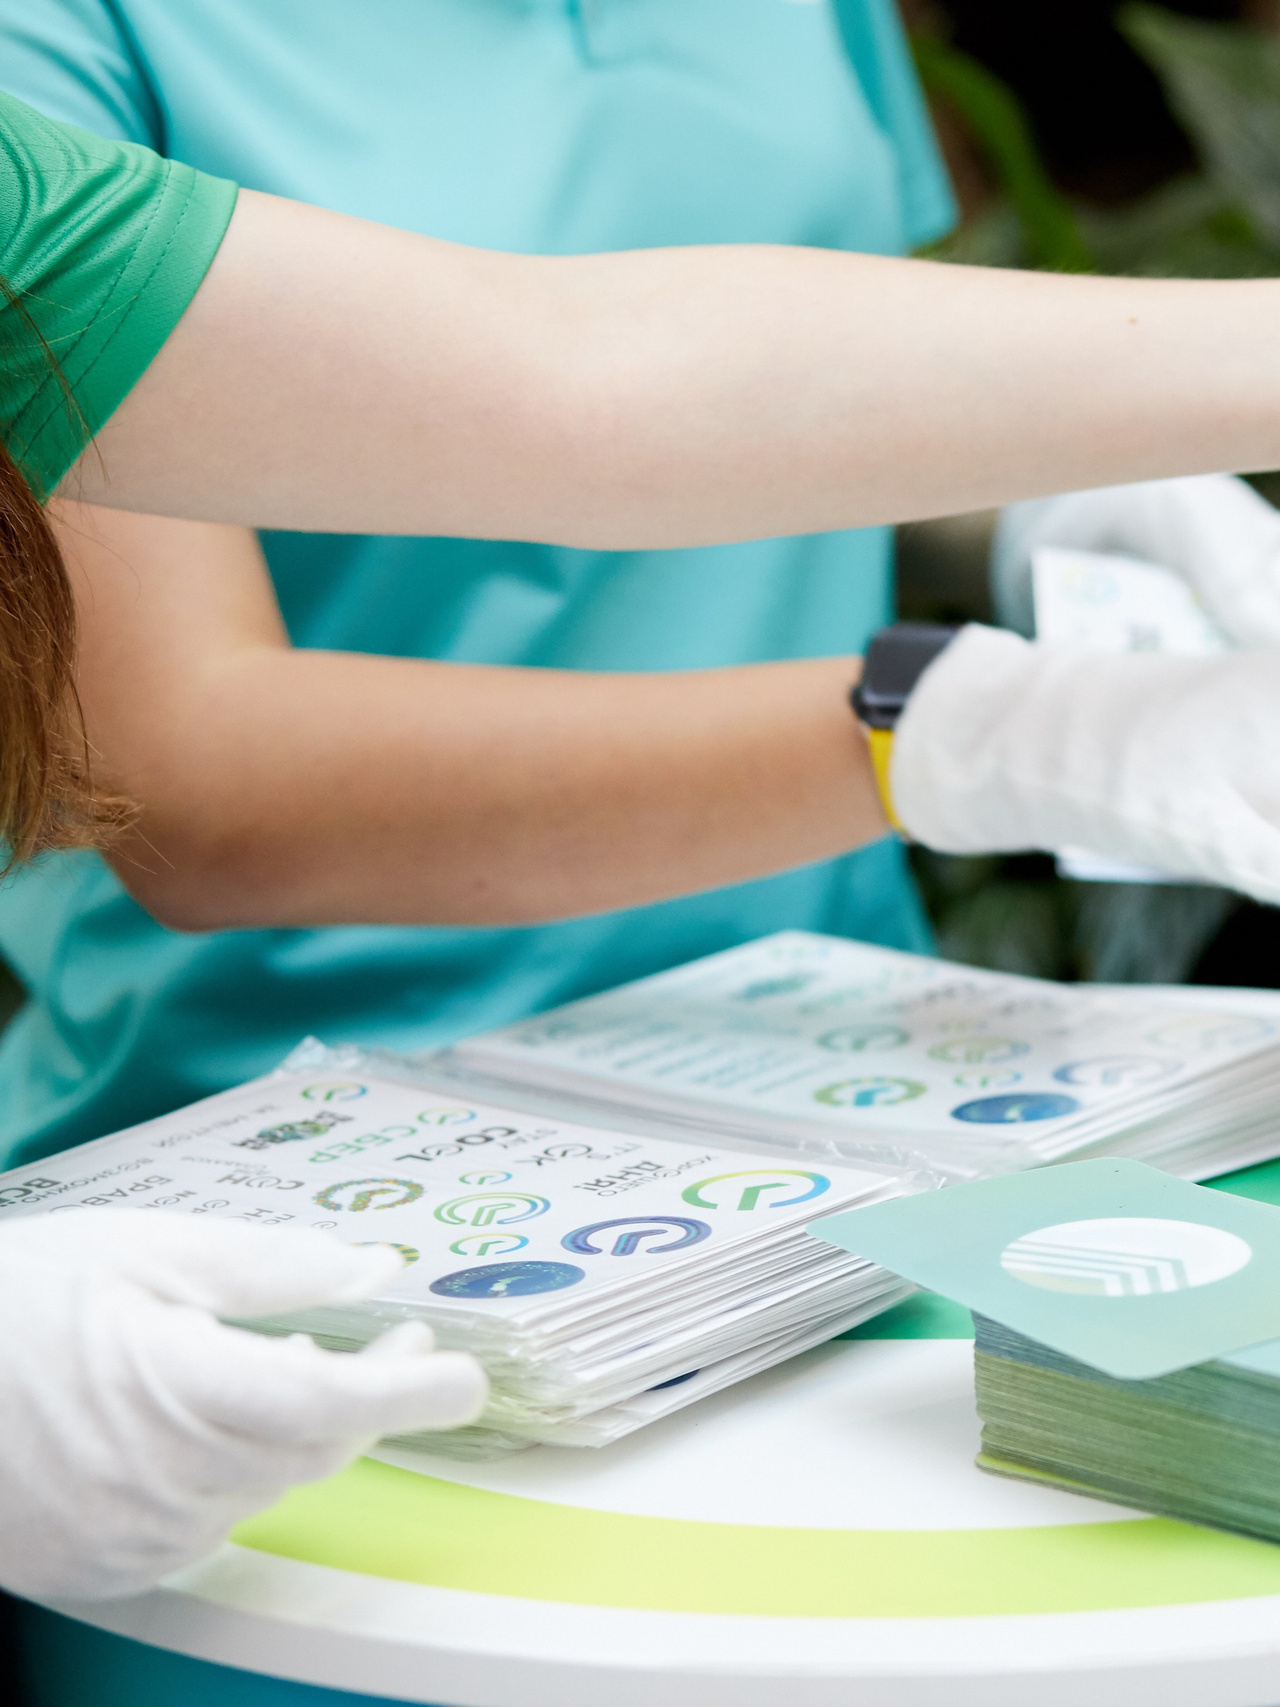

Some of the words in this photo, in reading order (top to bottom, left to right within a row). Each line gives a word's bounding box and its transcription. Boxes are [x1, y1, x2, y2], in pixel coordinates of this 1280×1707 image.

[308, 1124, 418, 1163] СБЕР
[394, 1126, 518, 1162] COOL
[21, 1157, 154, 1203] ВОЗМОЖНО
[573, 1160, 665, 1192] ДНЯ!
